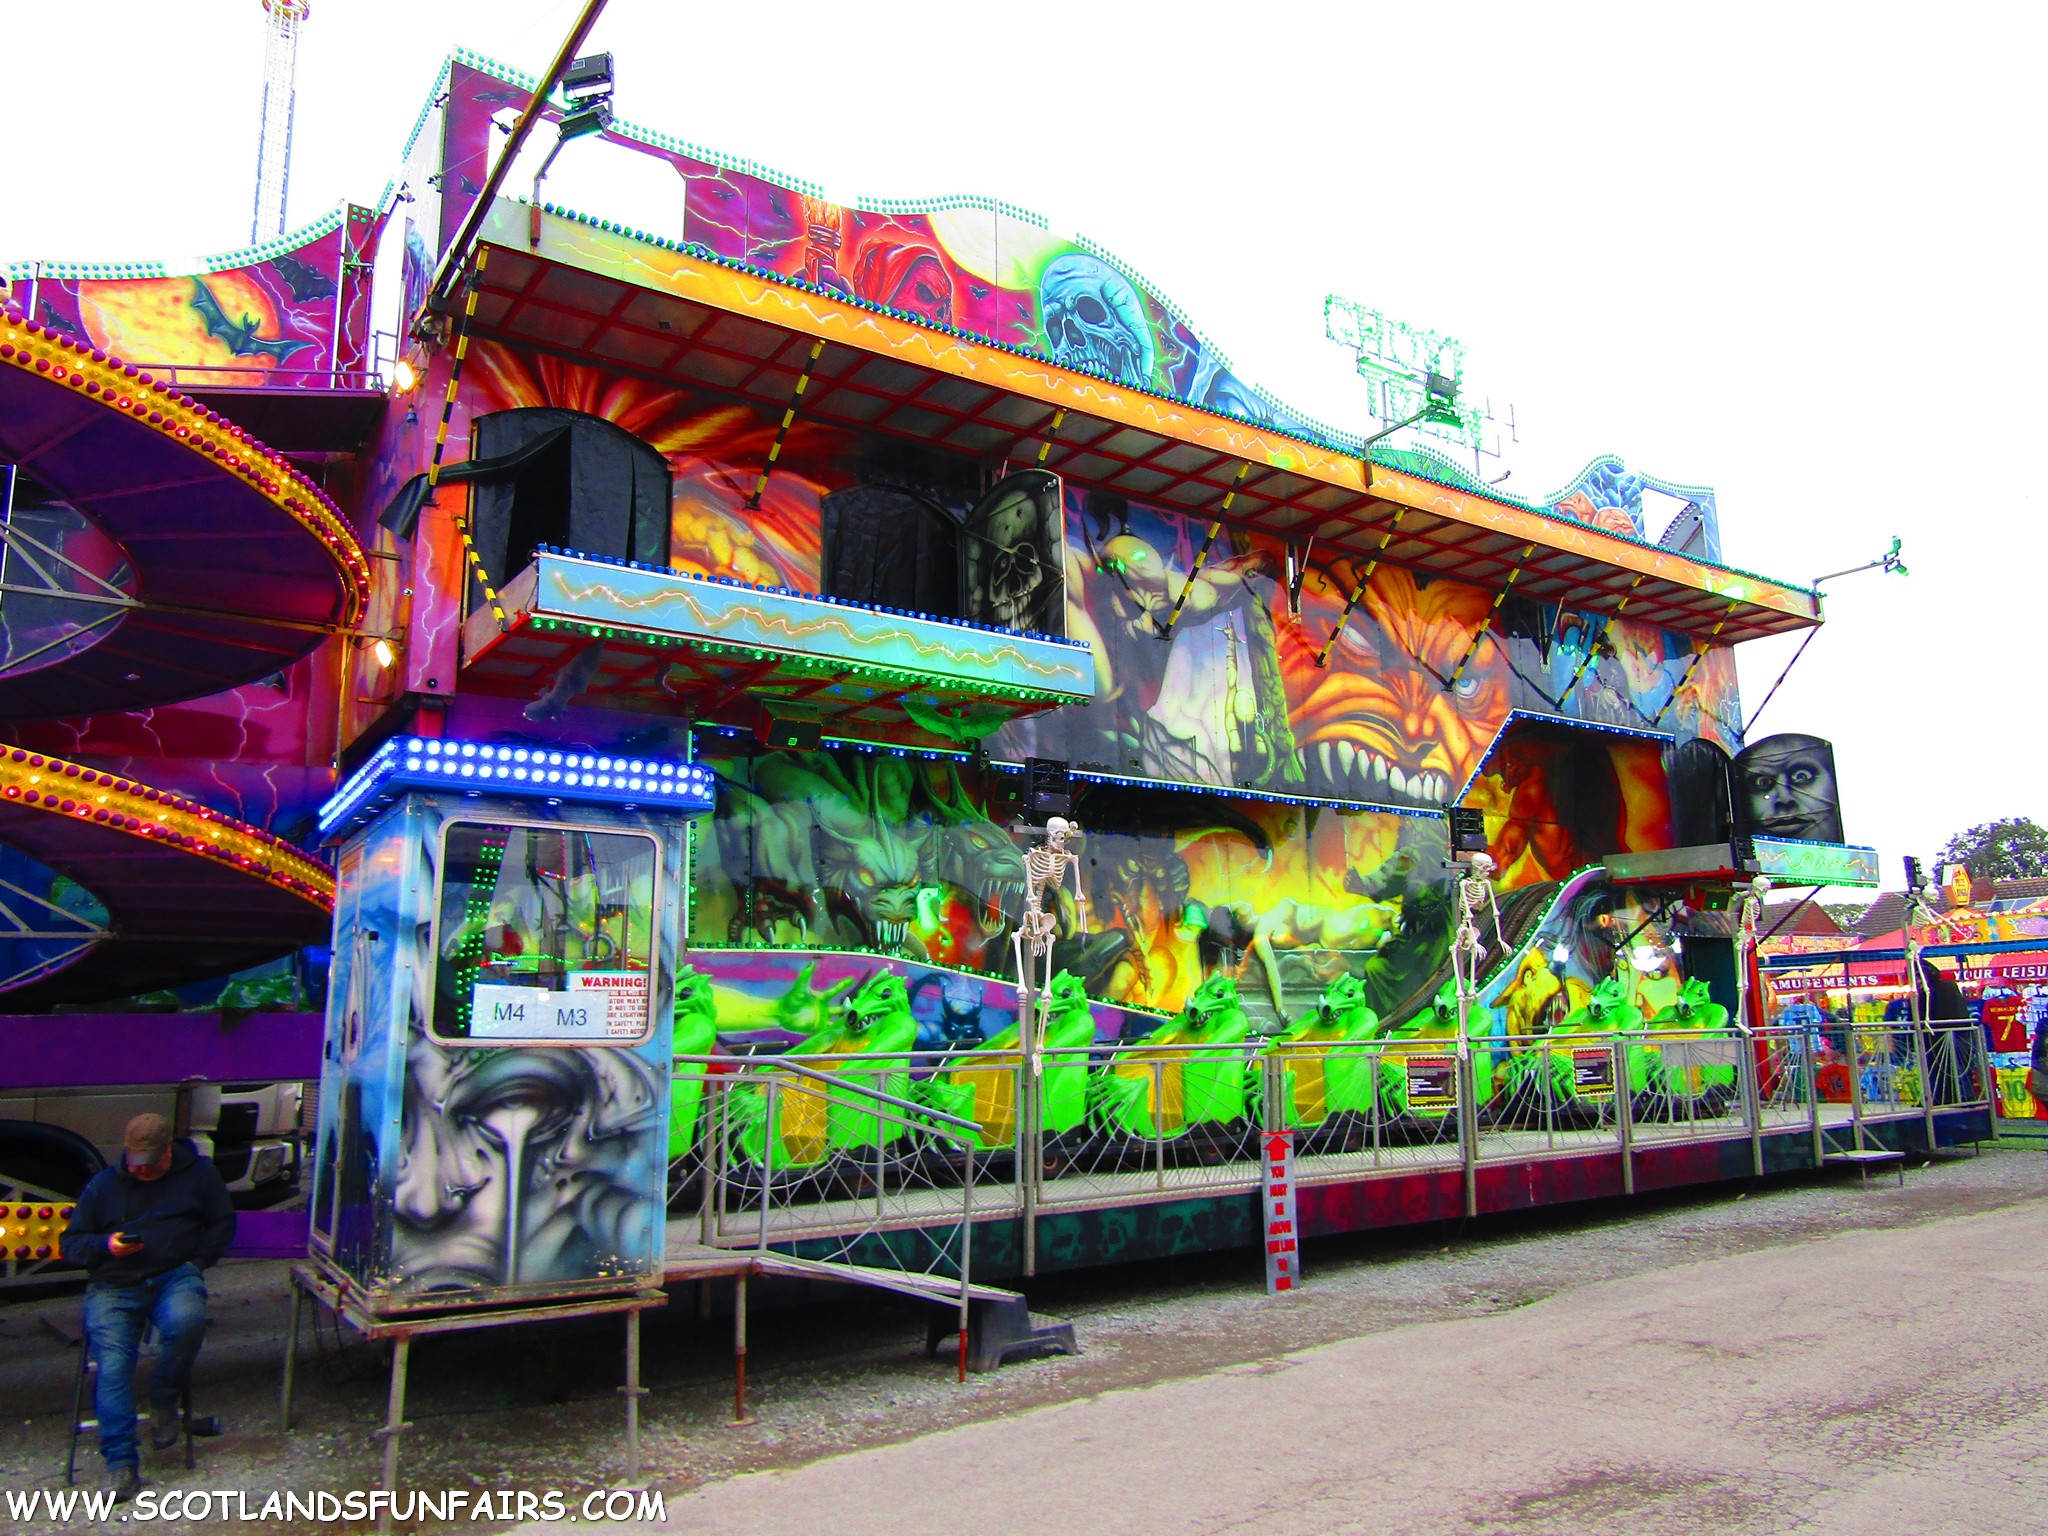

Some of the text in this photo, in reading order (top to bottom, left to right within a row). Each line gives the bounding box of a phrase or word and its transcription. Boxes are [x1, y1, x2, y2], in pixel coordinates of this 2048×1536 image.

[581, 977, 647, 987] WARNING!
[494, 1002, 525, 1022] M4
[556, 1008, 587, 1027] M3
[1997, 1014, 2016, 1041] 7
[2005, 1080, 2027, 1102] 10
